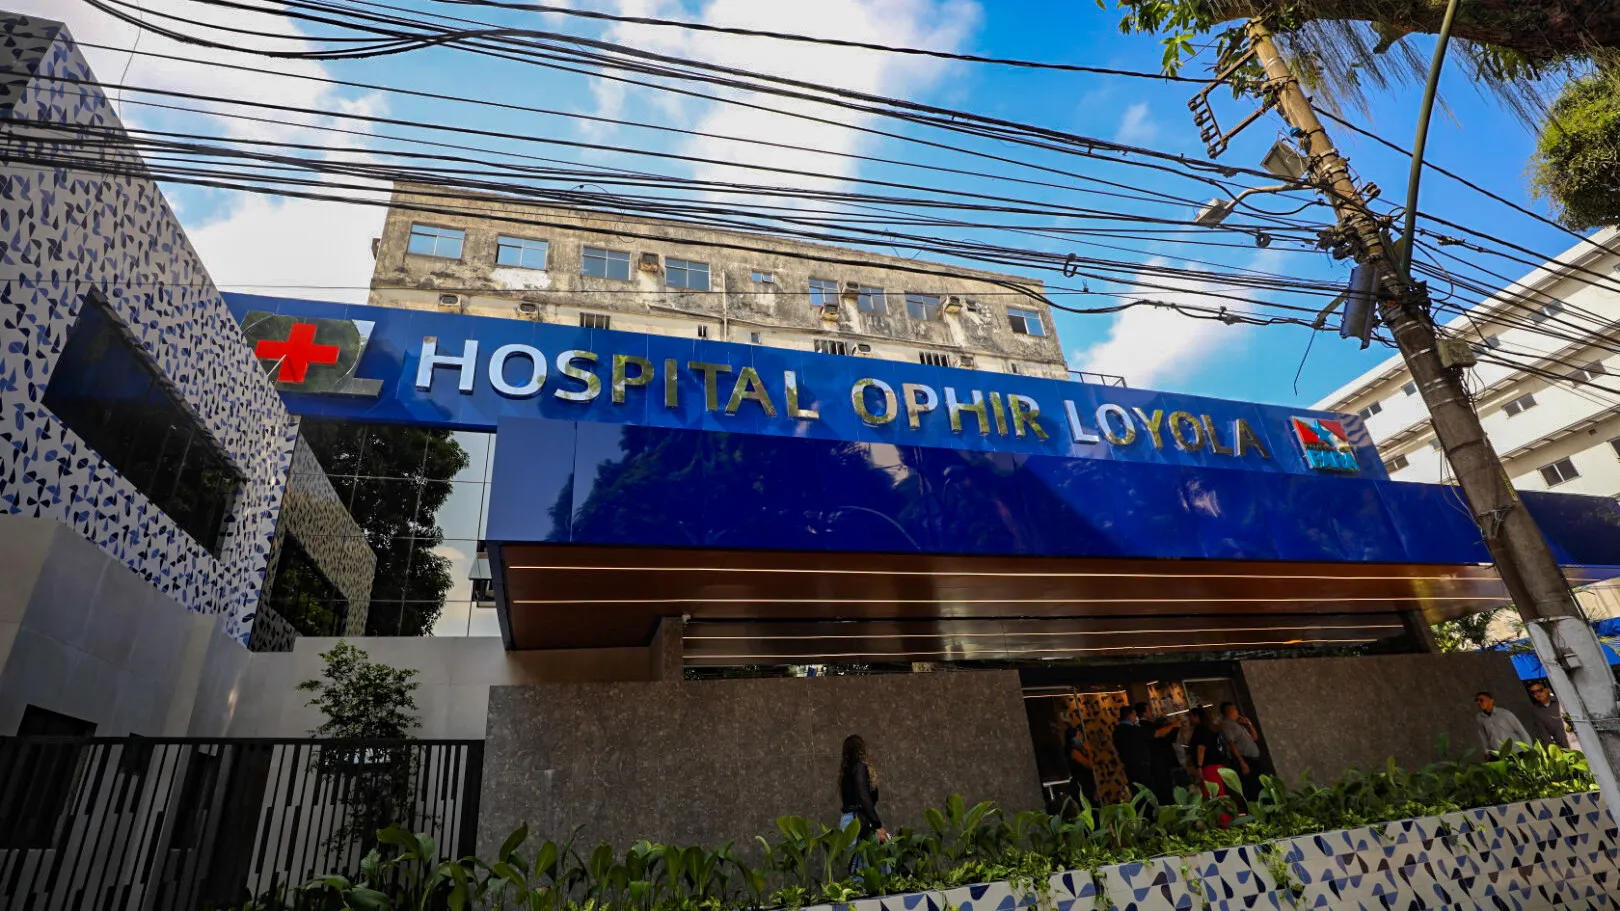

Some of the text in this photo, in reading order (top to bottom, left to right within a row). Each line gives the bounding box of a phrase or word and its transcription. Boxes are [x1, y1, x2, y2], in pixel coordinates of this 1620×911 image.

[415, 335, 820, 420] HOSPITAL
[851, 376, 1050, 441] OPHIR
[1063, 398, 1272, 460] LOYOLA
